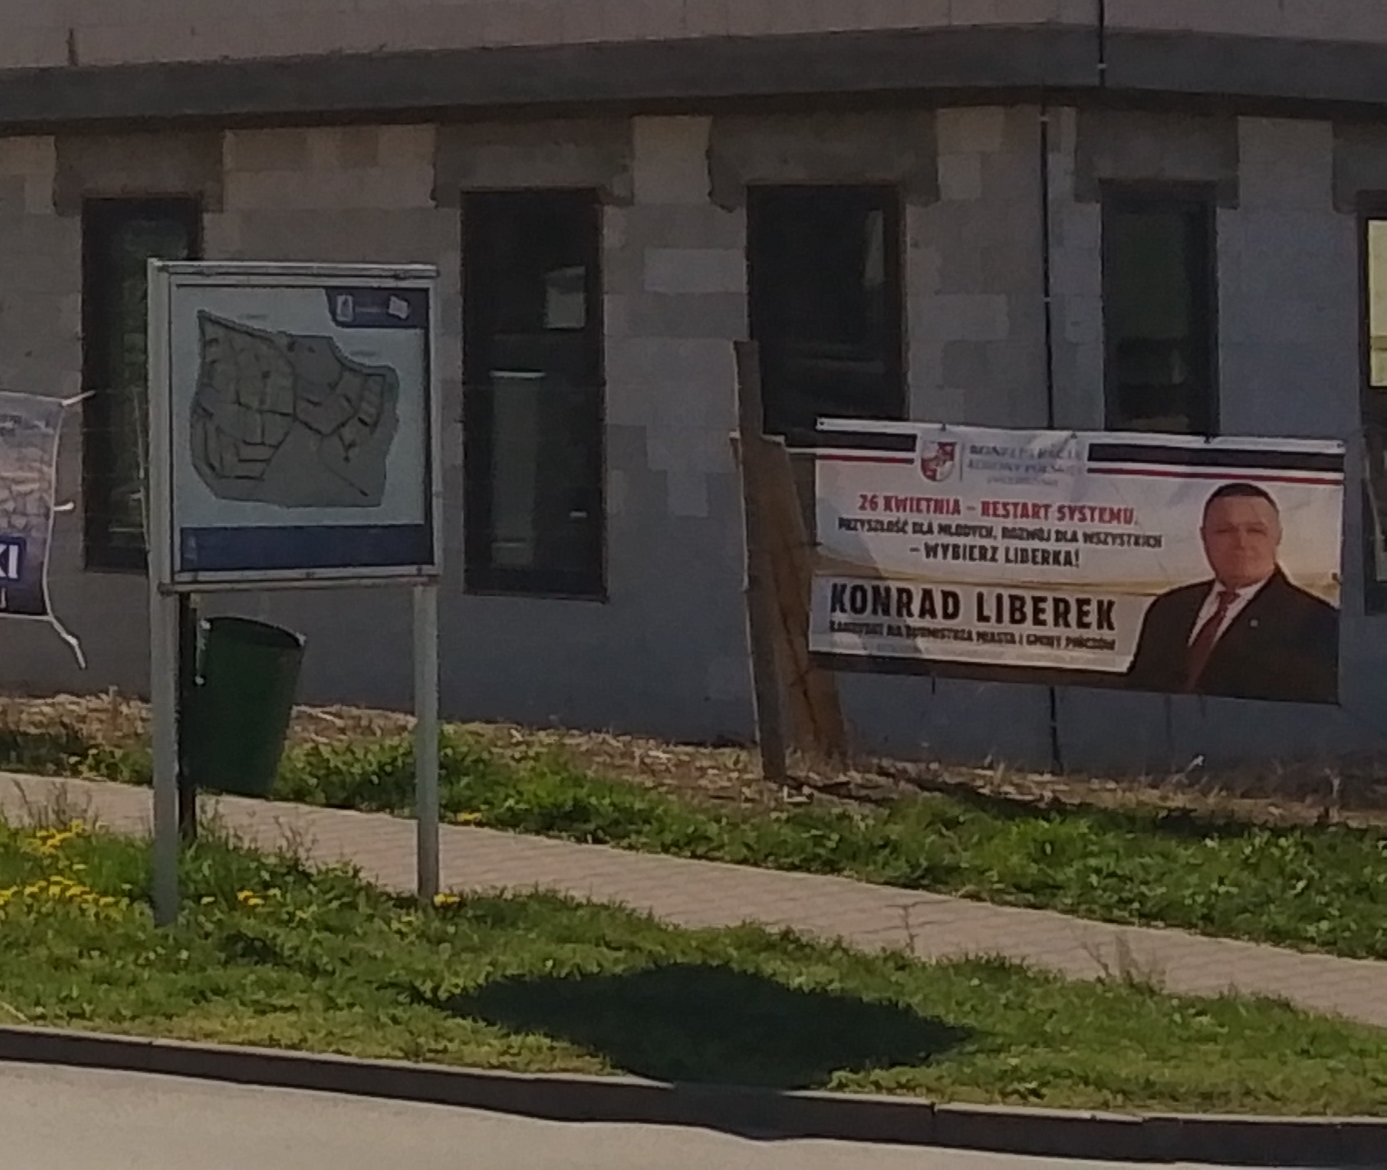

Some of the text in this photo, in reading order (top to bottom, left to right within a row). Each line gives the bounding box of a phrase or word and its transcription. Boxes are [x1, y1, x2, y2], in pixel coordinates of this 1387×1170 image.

[857, 493, 879, 512] 26
[883, 495, 962, 516] KWIETNIA
[980, 499, 1052, 521] RESTART
[912, 520, 934, 535] DLA
[1054, 528, 1079, 543] DLA
[924, 541, 999, 564] WYBIERZ
[829, 582, 1116, 632] KONRAD LIBEREK
